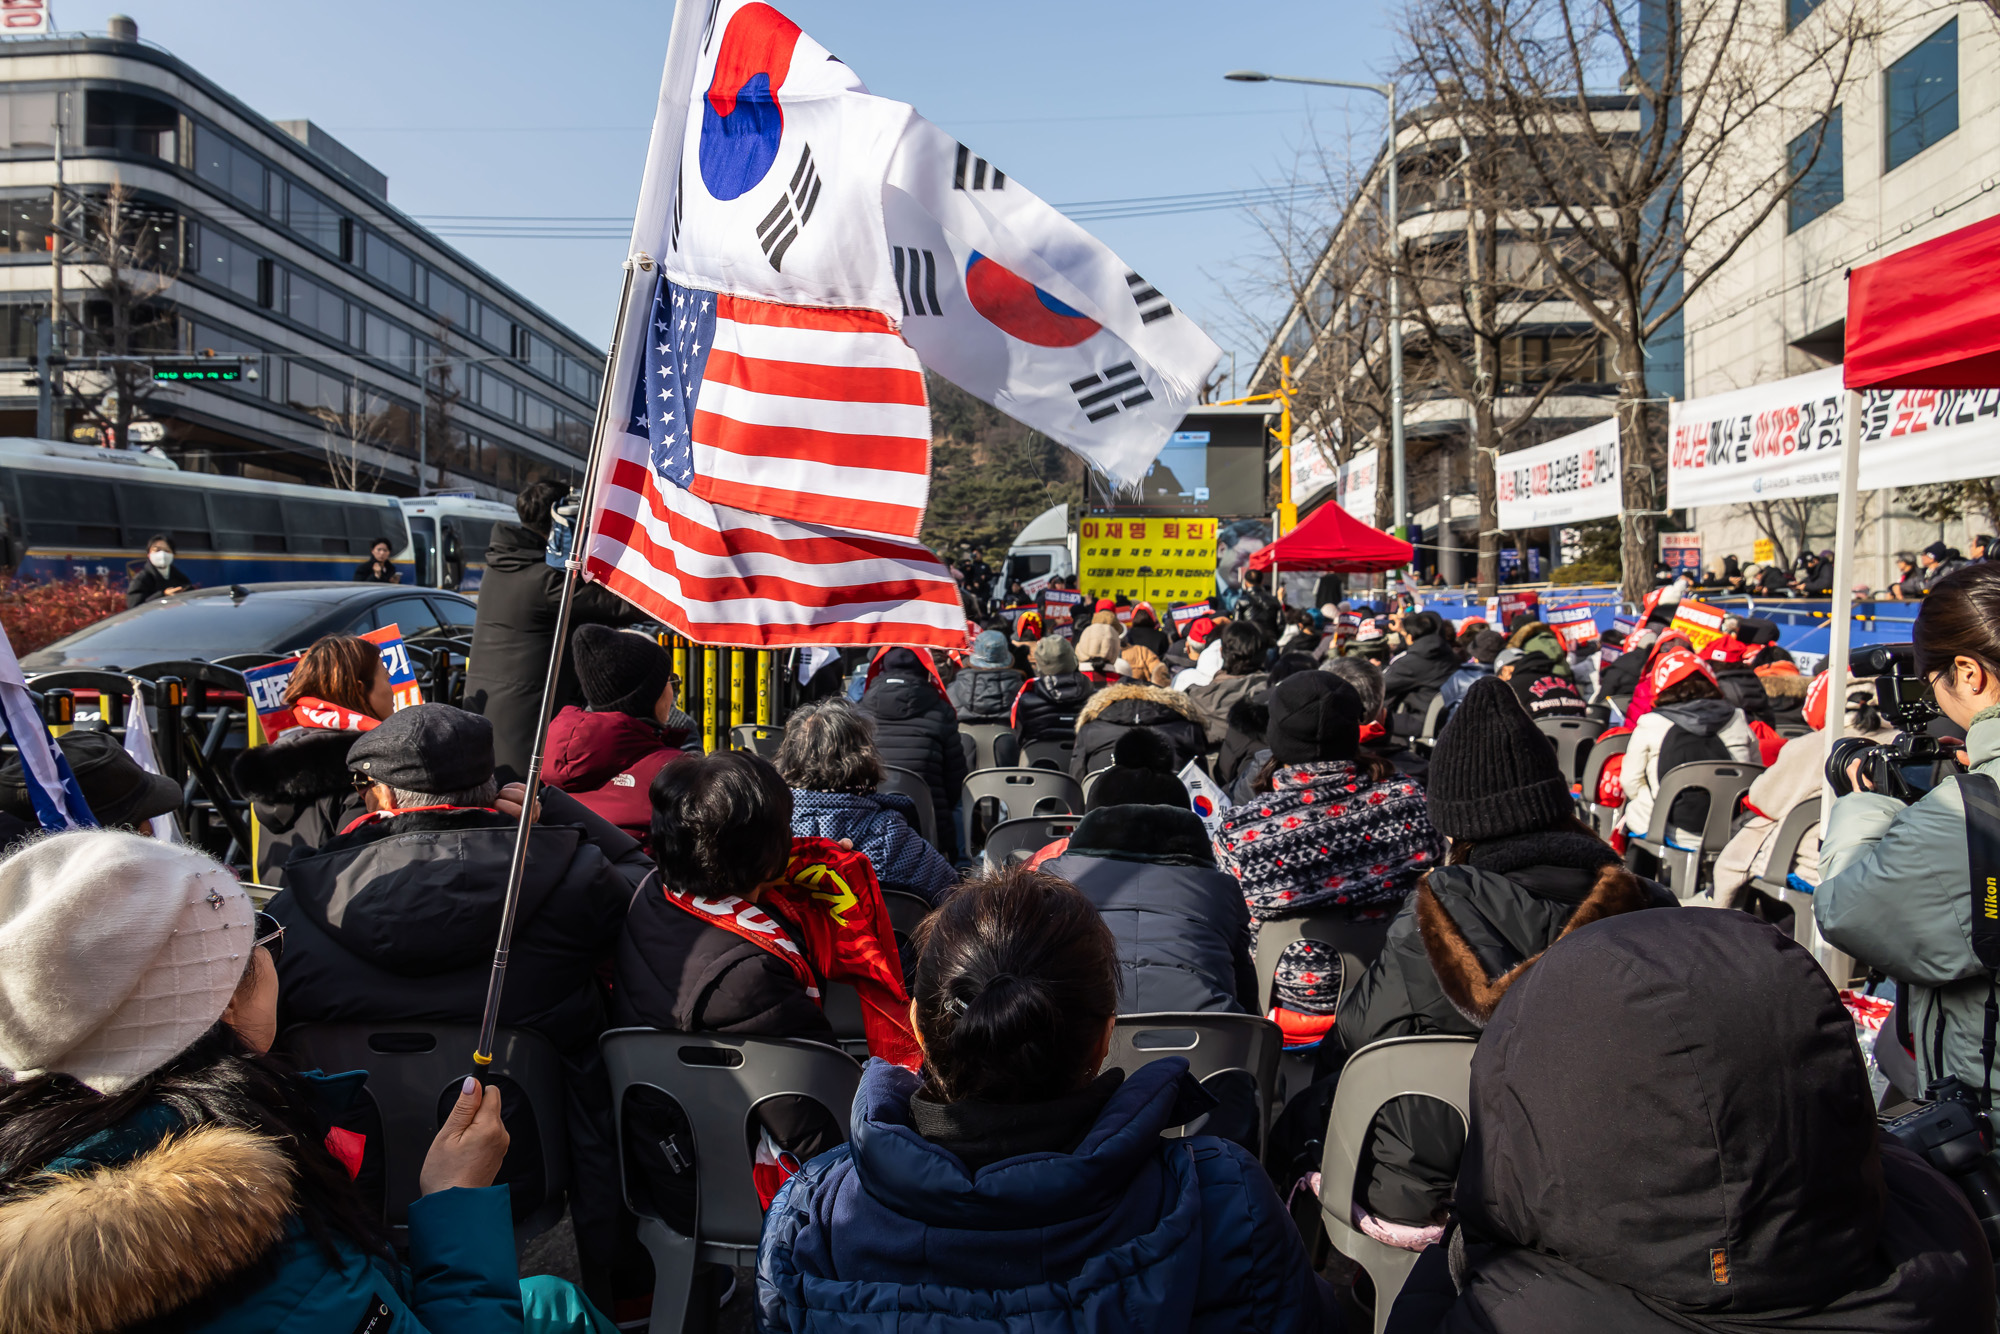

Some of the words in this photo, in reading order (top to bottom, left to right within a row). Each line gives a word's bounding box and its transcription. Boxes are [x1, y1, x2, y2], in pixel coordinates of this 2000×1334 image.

[1752, 400, 1816, 460] 이재명과
[1083, 522, 1147, 540] 이재명
[1163, 523, 1216, 540] 퇴진!
[1086, 547, 1122, 557] 이재명
[1129, 547, 1153, 557] 재판
[1984, 876, 1998, 920] Nikon
